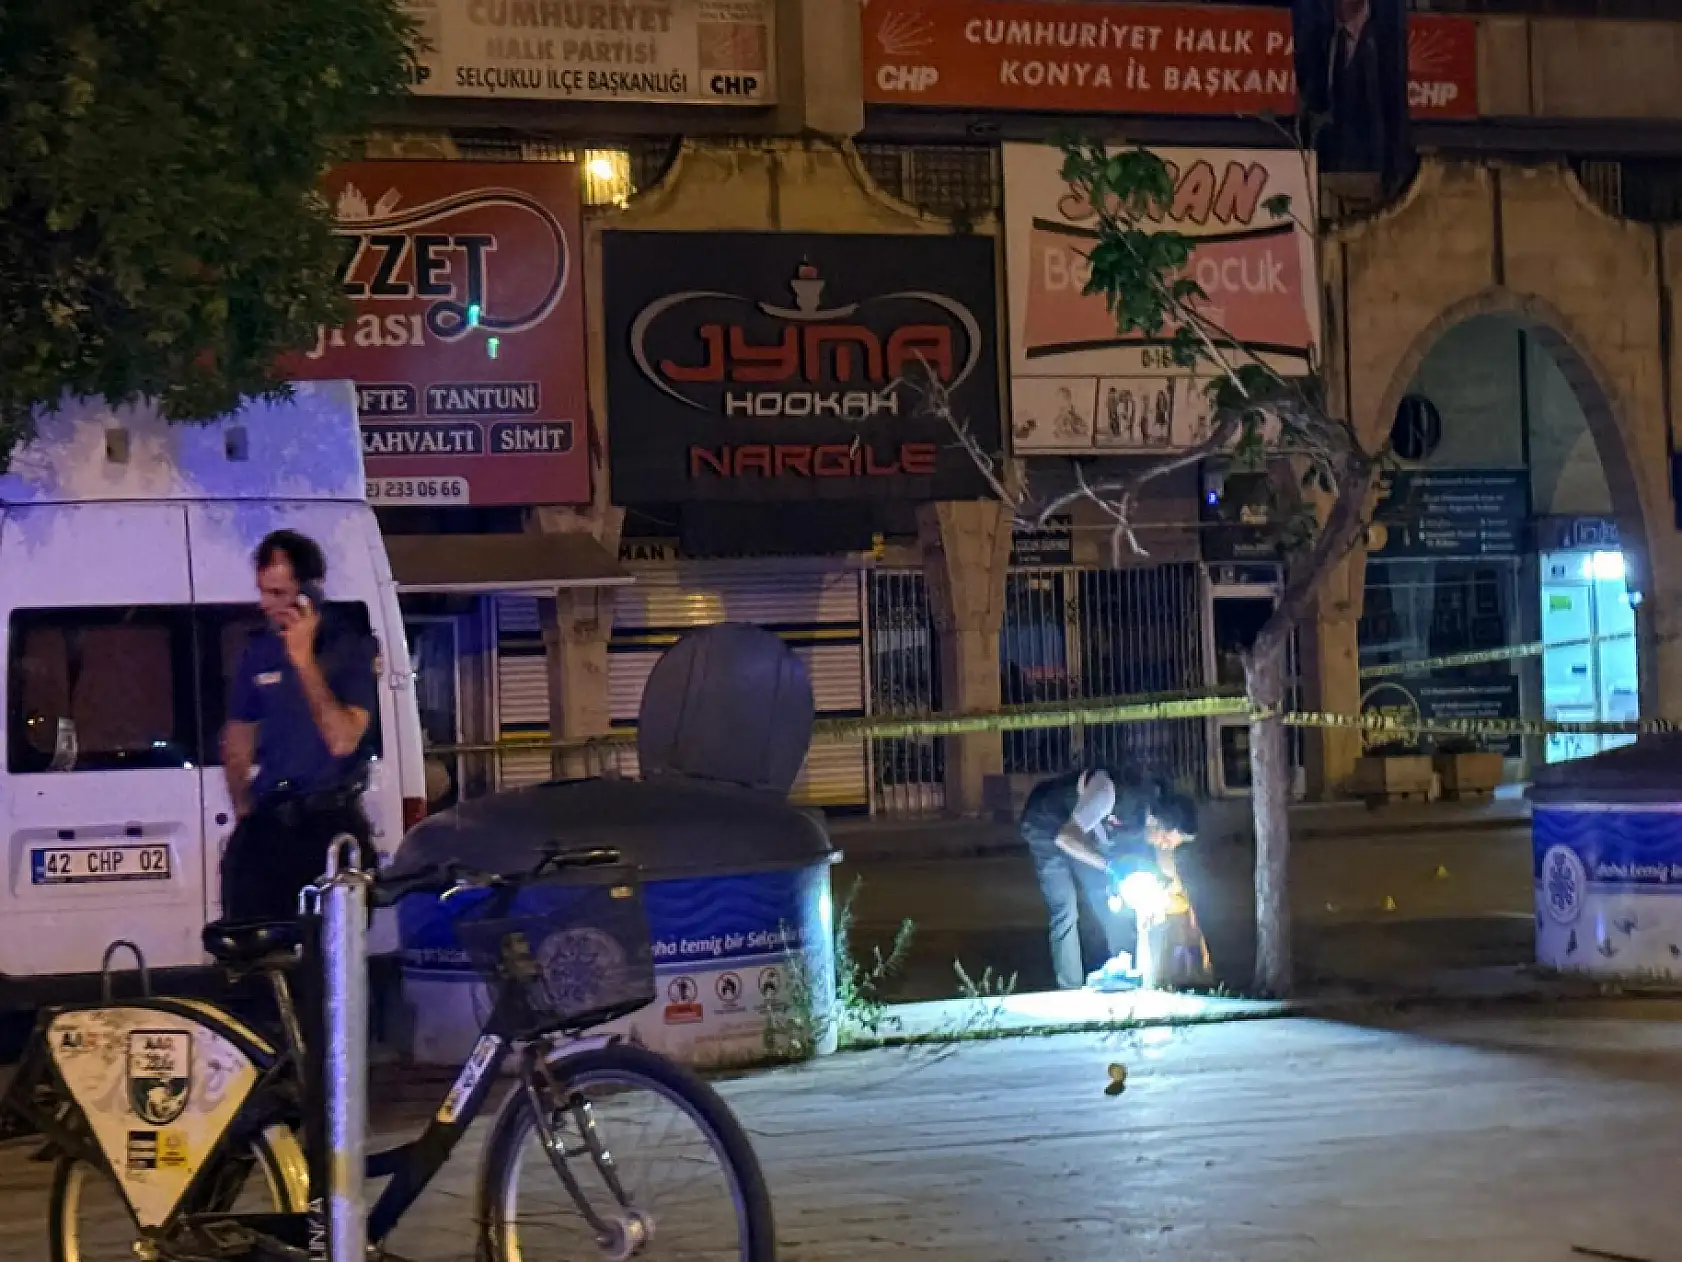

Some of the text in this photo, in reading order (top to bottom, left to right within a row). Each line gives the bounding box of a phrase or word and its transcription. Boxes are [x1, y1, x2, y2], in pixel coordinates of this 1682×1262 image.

[486, 32, 660, 65] HALK PARTİSİ
[964, 16, 1163, 51] CUMHURİYET
[1175, 29, 1255, 56] HALK
[456, 66, 541, 94] SELÇUKLU
[547, 65, 583, 95] İLÇE
[588, 68, 688, 97] BAŞKANLIĞI
[709, 74, 757, 96] CHP
[876, 66, 940, 92] CHP
[1000, 59, 1112, 88] KONYA
[1126, 56, 1151, 91] İL
[332, 234, 498, 318] ZZET
[1184, 250, 1288, 294] ocuk
[660, 324, 953, 383] JYMA
[361, 382, 536, 411] FTE TANTUNİ
[726, 391, 899, 417] HOOKAH
[500, 424, 564, 451] SİMİT
[47, 849, 165, 875] 42 CHP 02
